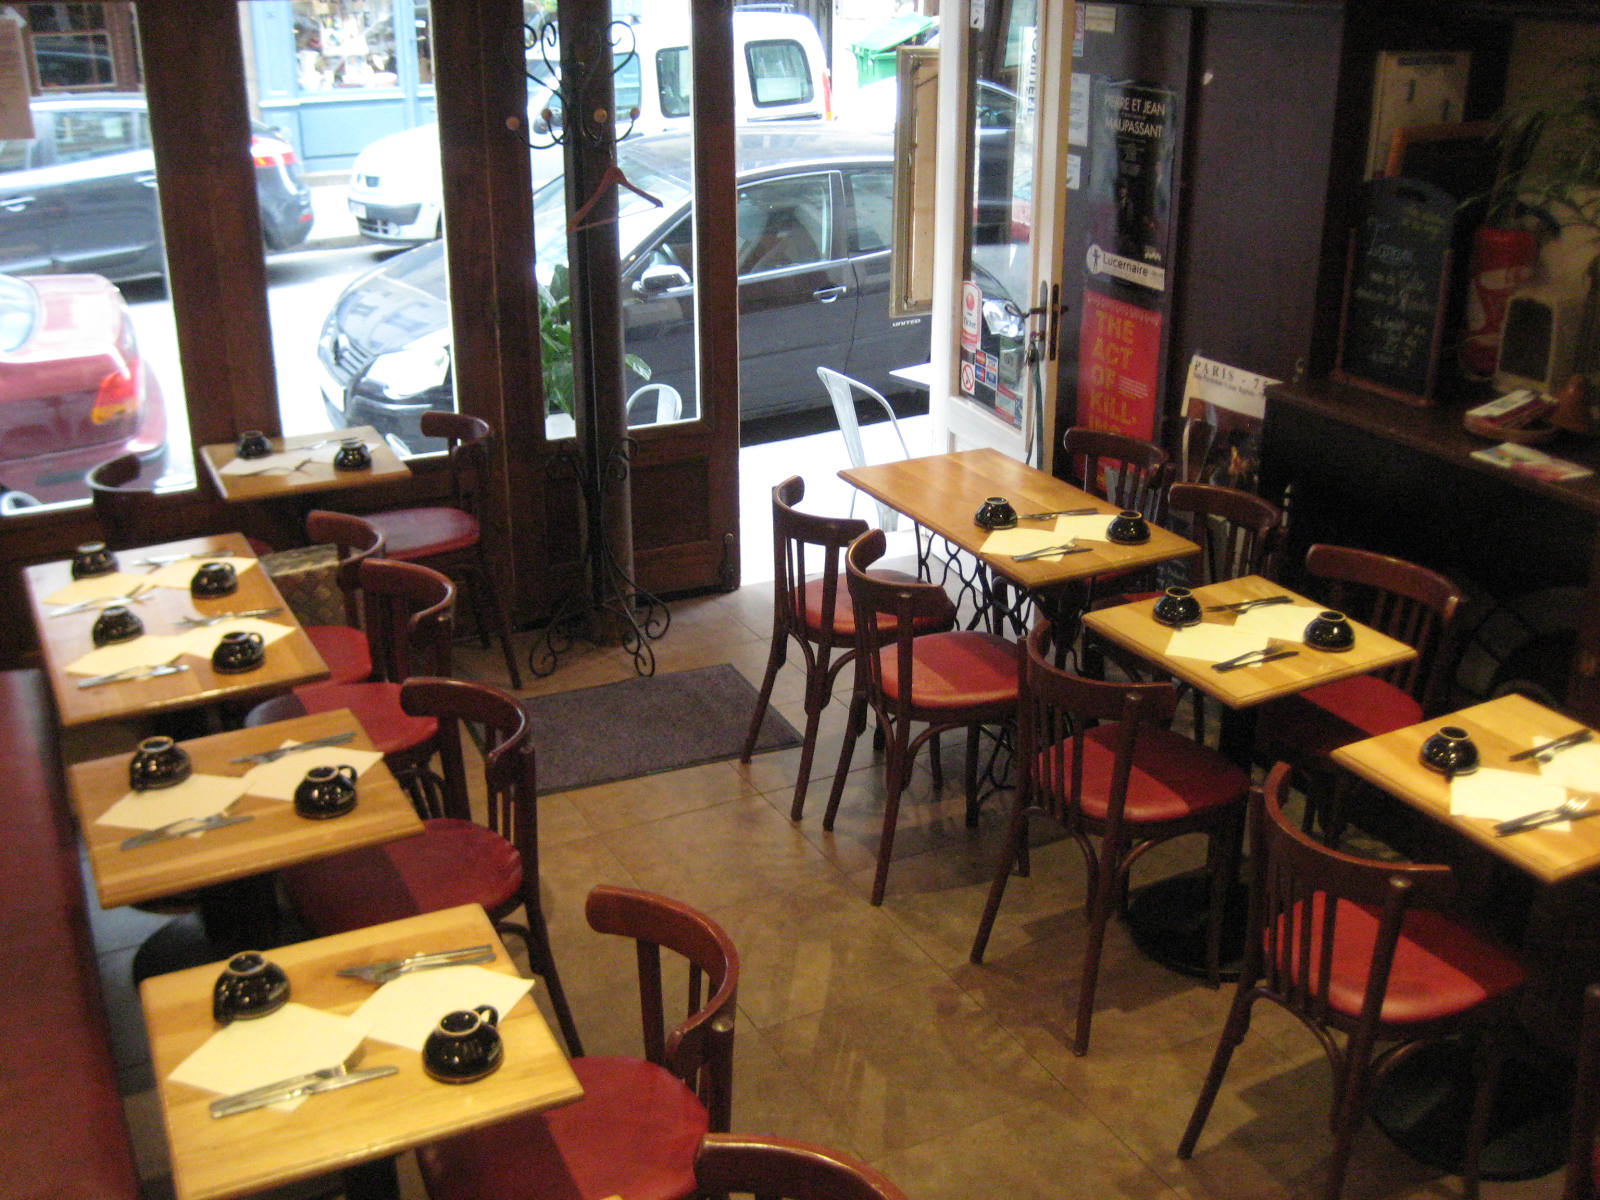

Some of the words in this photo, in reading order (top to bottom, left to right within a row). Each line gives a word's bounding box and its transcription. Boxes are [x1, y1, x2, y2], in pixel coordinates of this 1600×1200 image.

[1131, 98, 1142, 113] ET
[1143, 100, 1166, 116] JEAN
[1104, 117, 1163, 138] MAUPASSANT
[1103, 253, 1149, 277] Lucernaire
[1096, 310, 1135, 344] THE
[1093, 337, 1133, 369] ACT
[1194, 360, 1234, 379] PARIS
